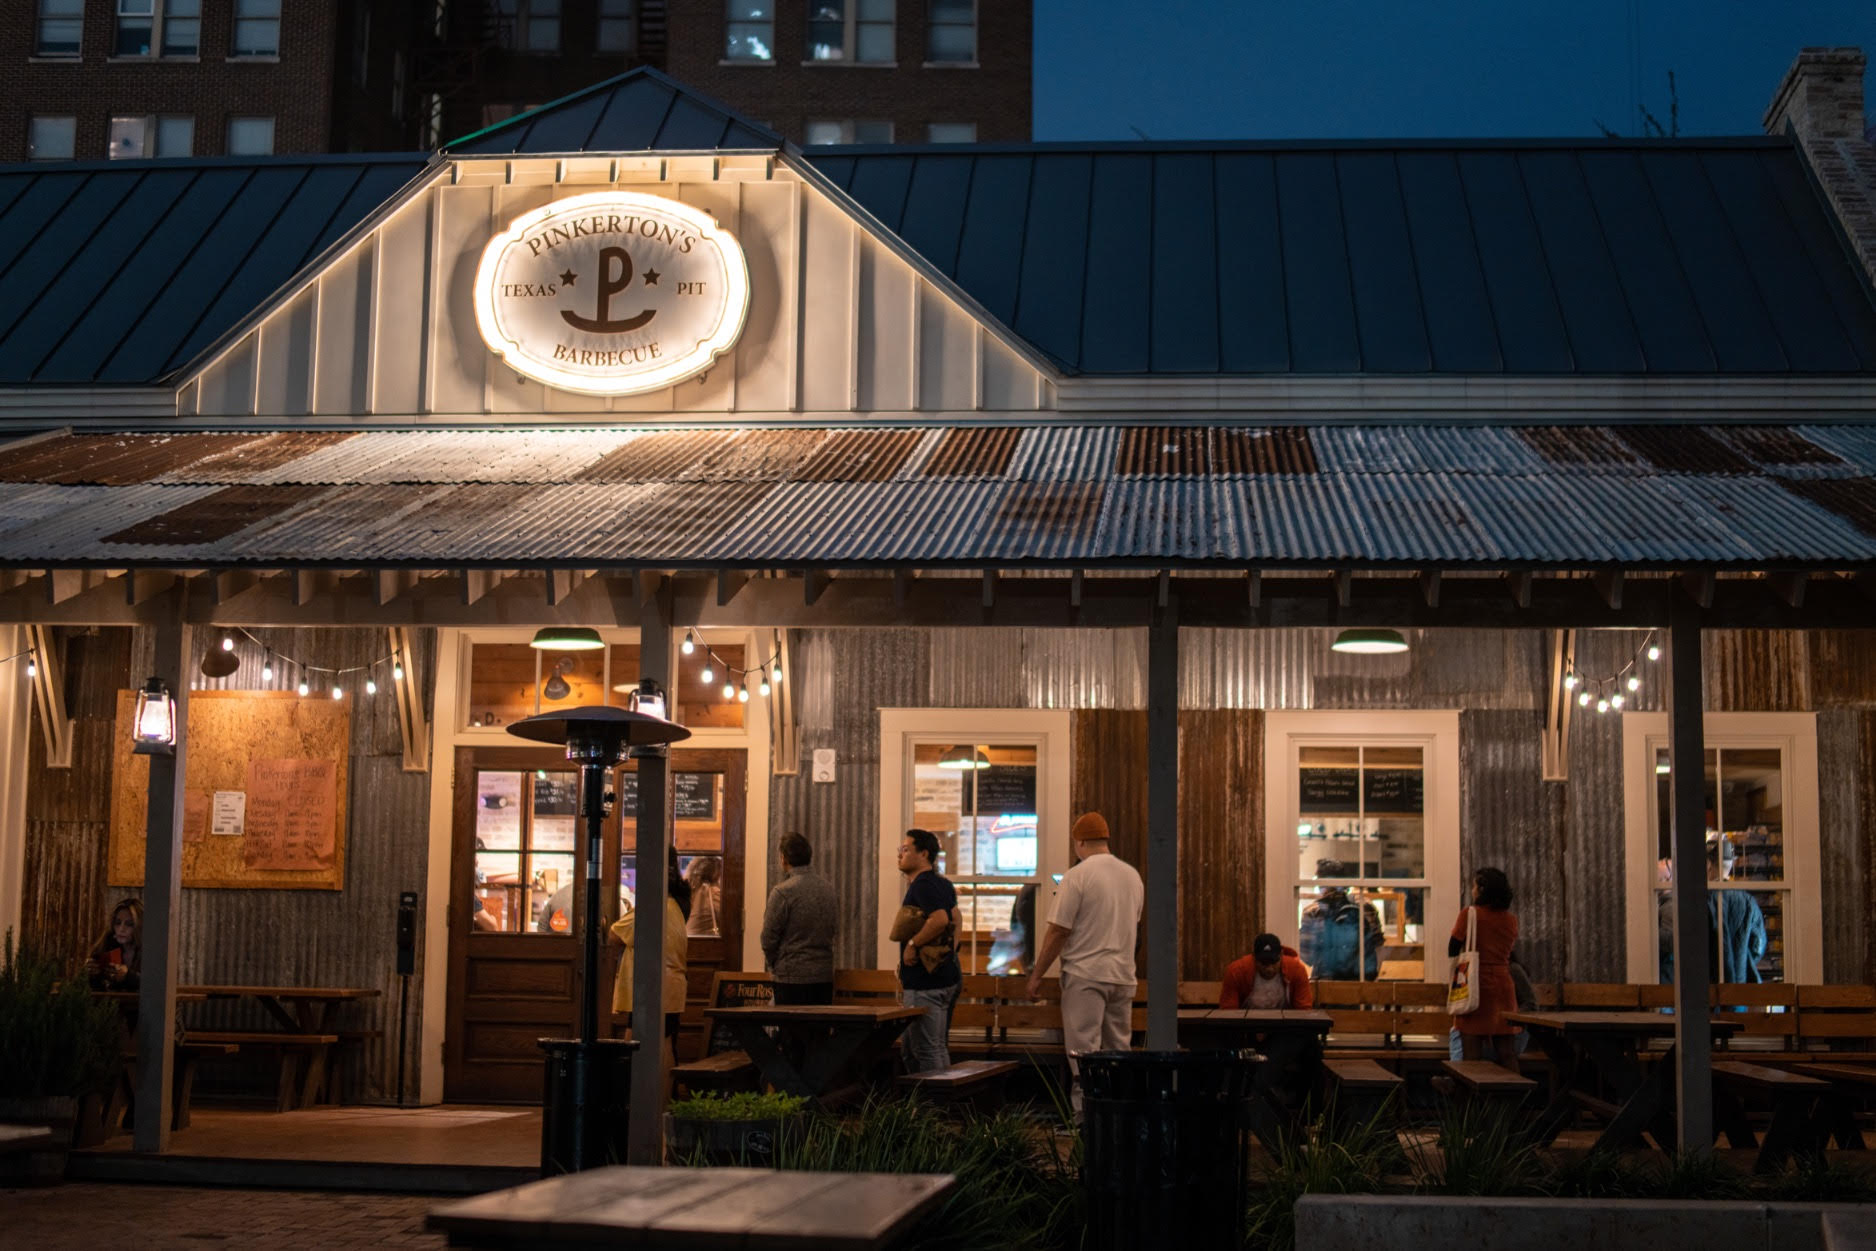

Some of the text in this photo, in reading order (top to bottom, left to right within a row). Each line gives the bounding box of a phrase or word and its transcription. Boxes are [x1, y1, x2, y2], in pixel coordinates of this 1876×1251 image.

[525, 215, 697, 257] PINKERTON'S
[501, 281, 707, 297] TEXAS PIT
[552, 342, 663, 367] BARBECUE
[738, 984, 757, 998] Four
